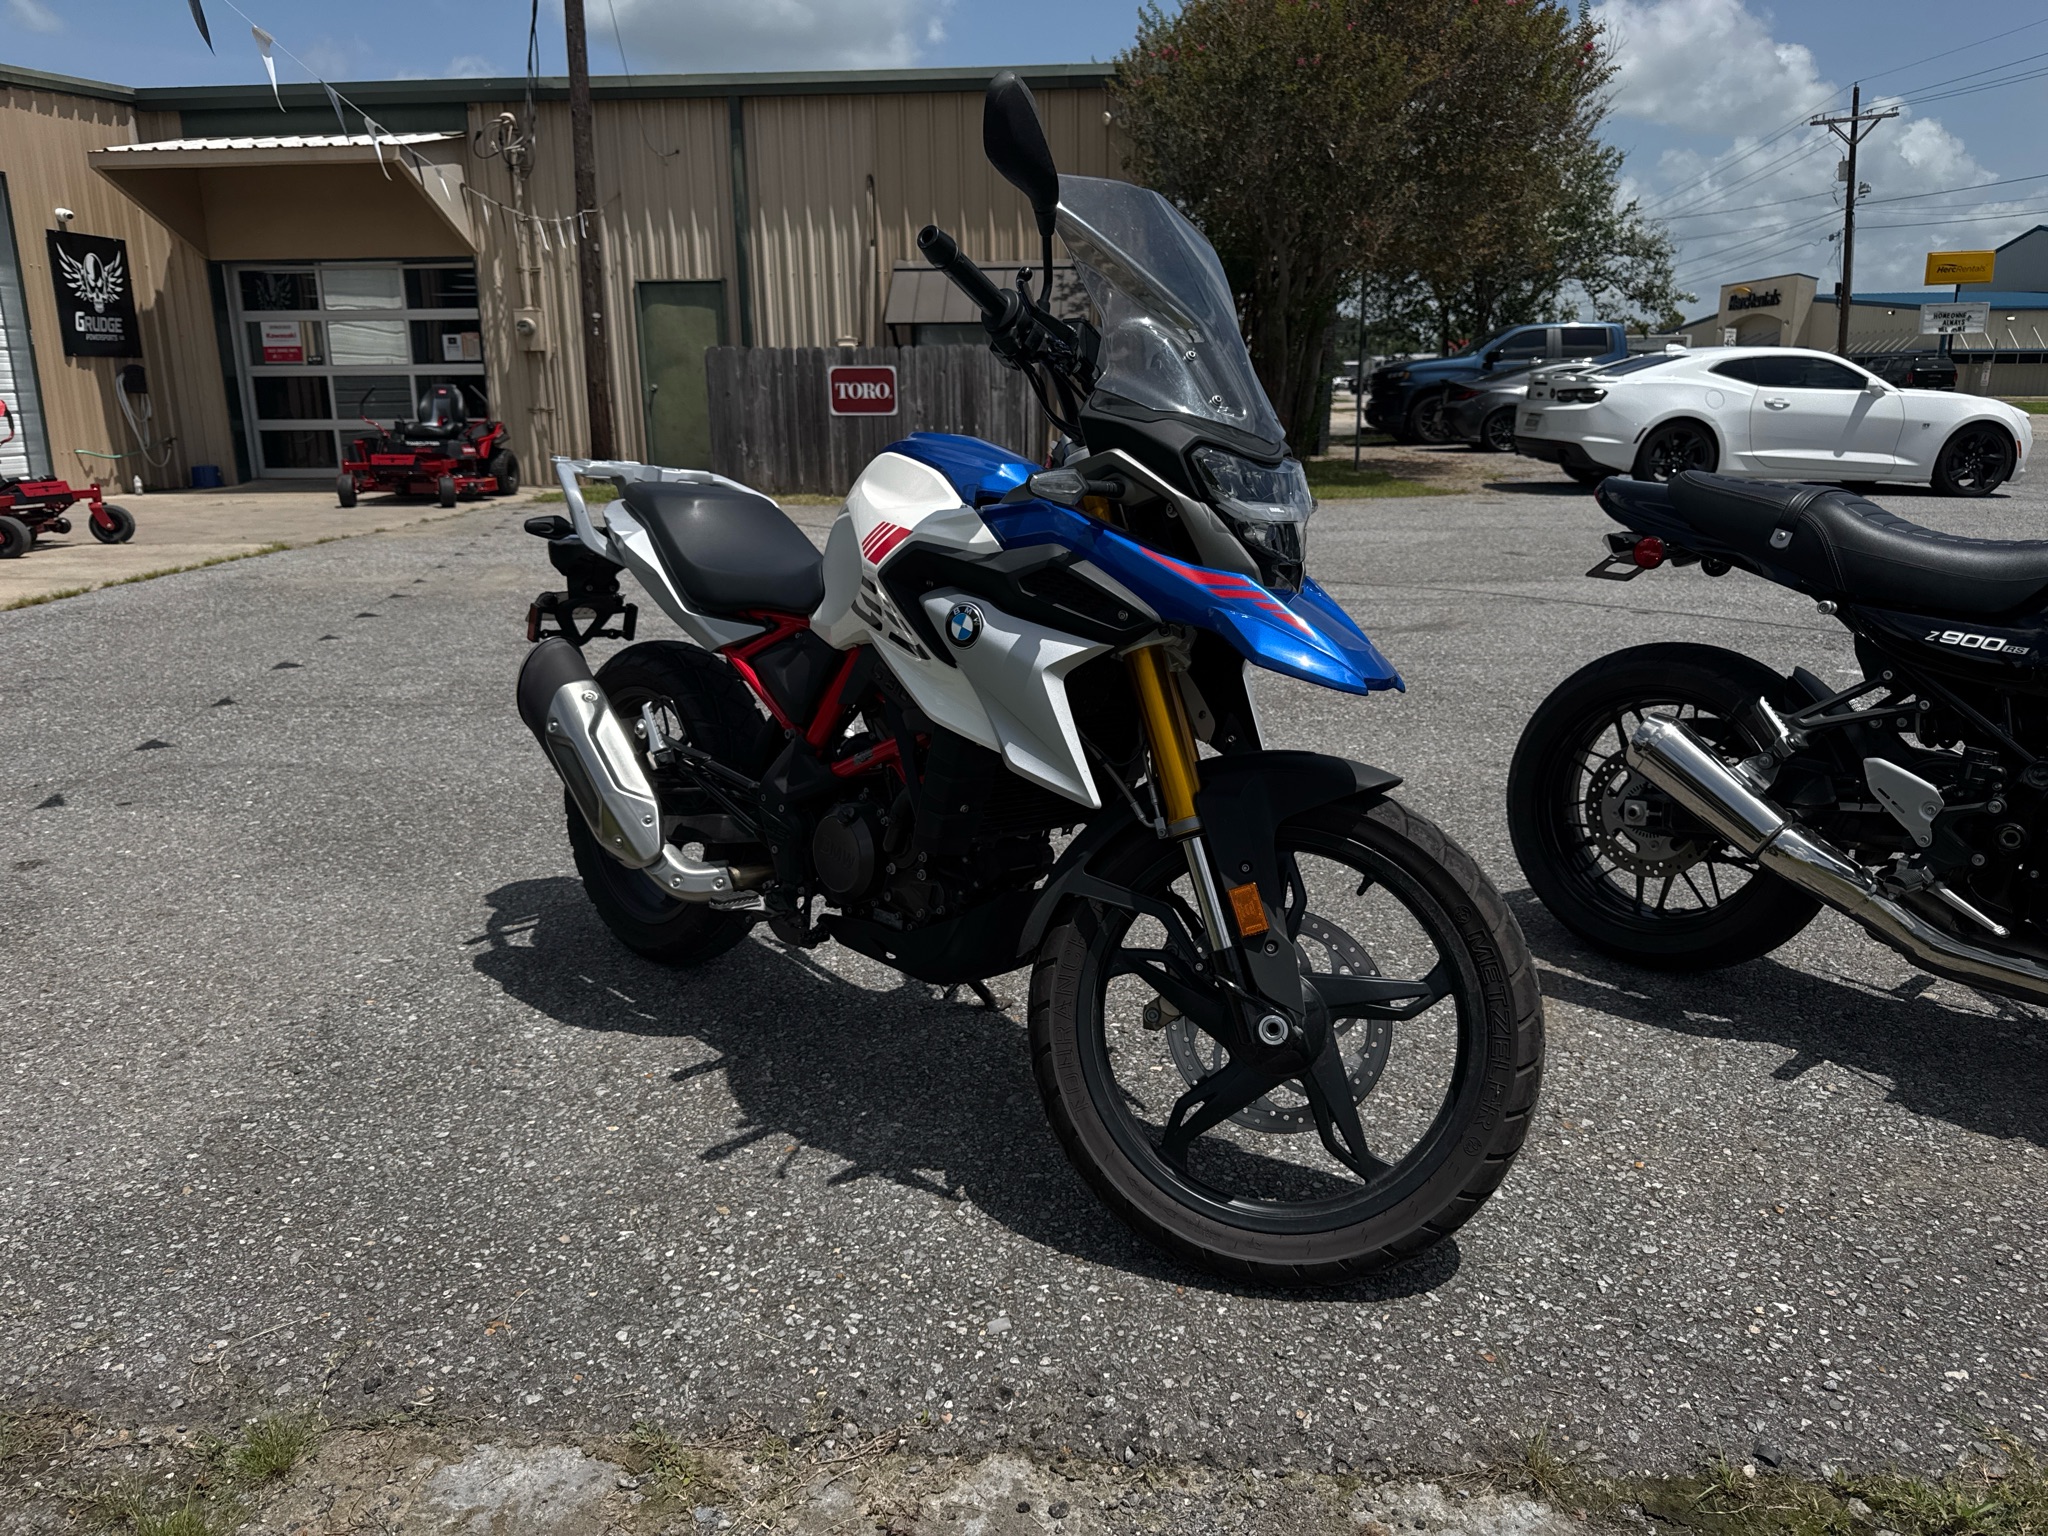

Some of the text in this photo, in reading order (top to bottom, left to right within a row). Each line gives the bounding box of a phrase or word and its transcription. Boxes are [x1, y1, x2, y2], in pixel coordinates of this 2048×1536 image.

[75, 311, 124, 333] GRUDGE
[835, 382, 890, 400] TORO
[1466, 931, 1512, 1132] METZELER
